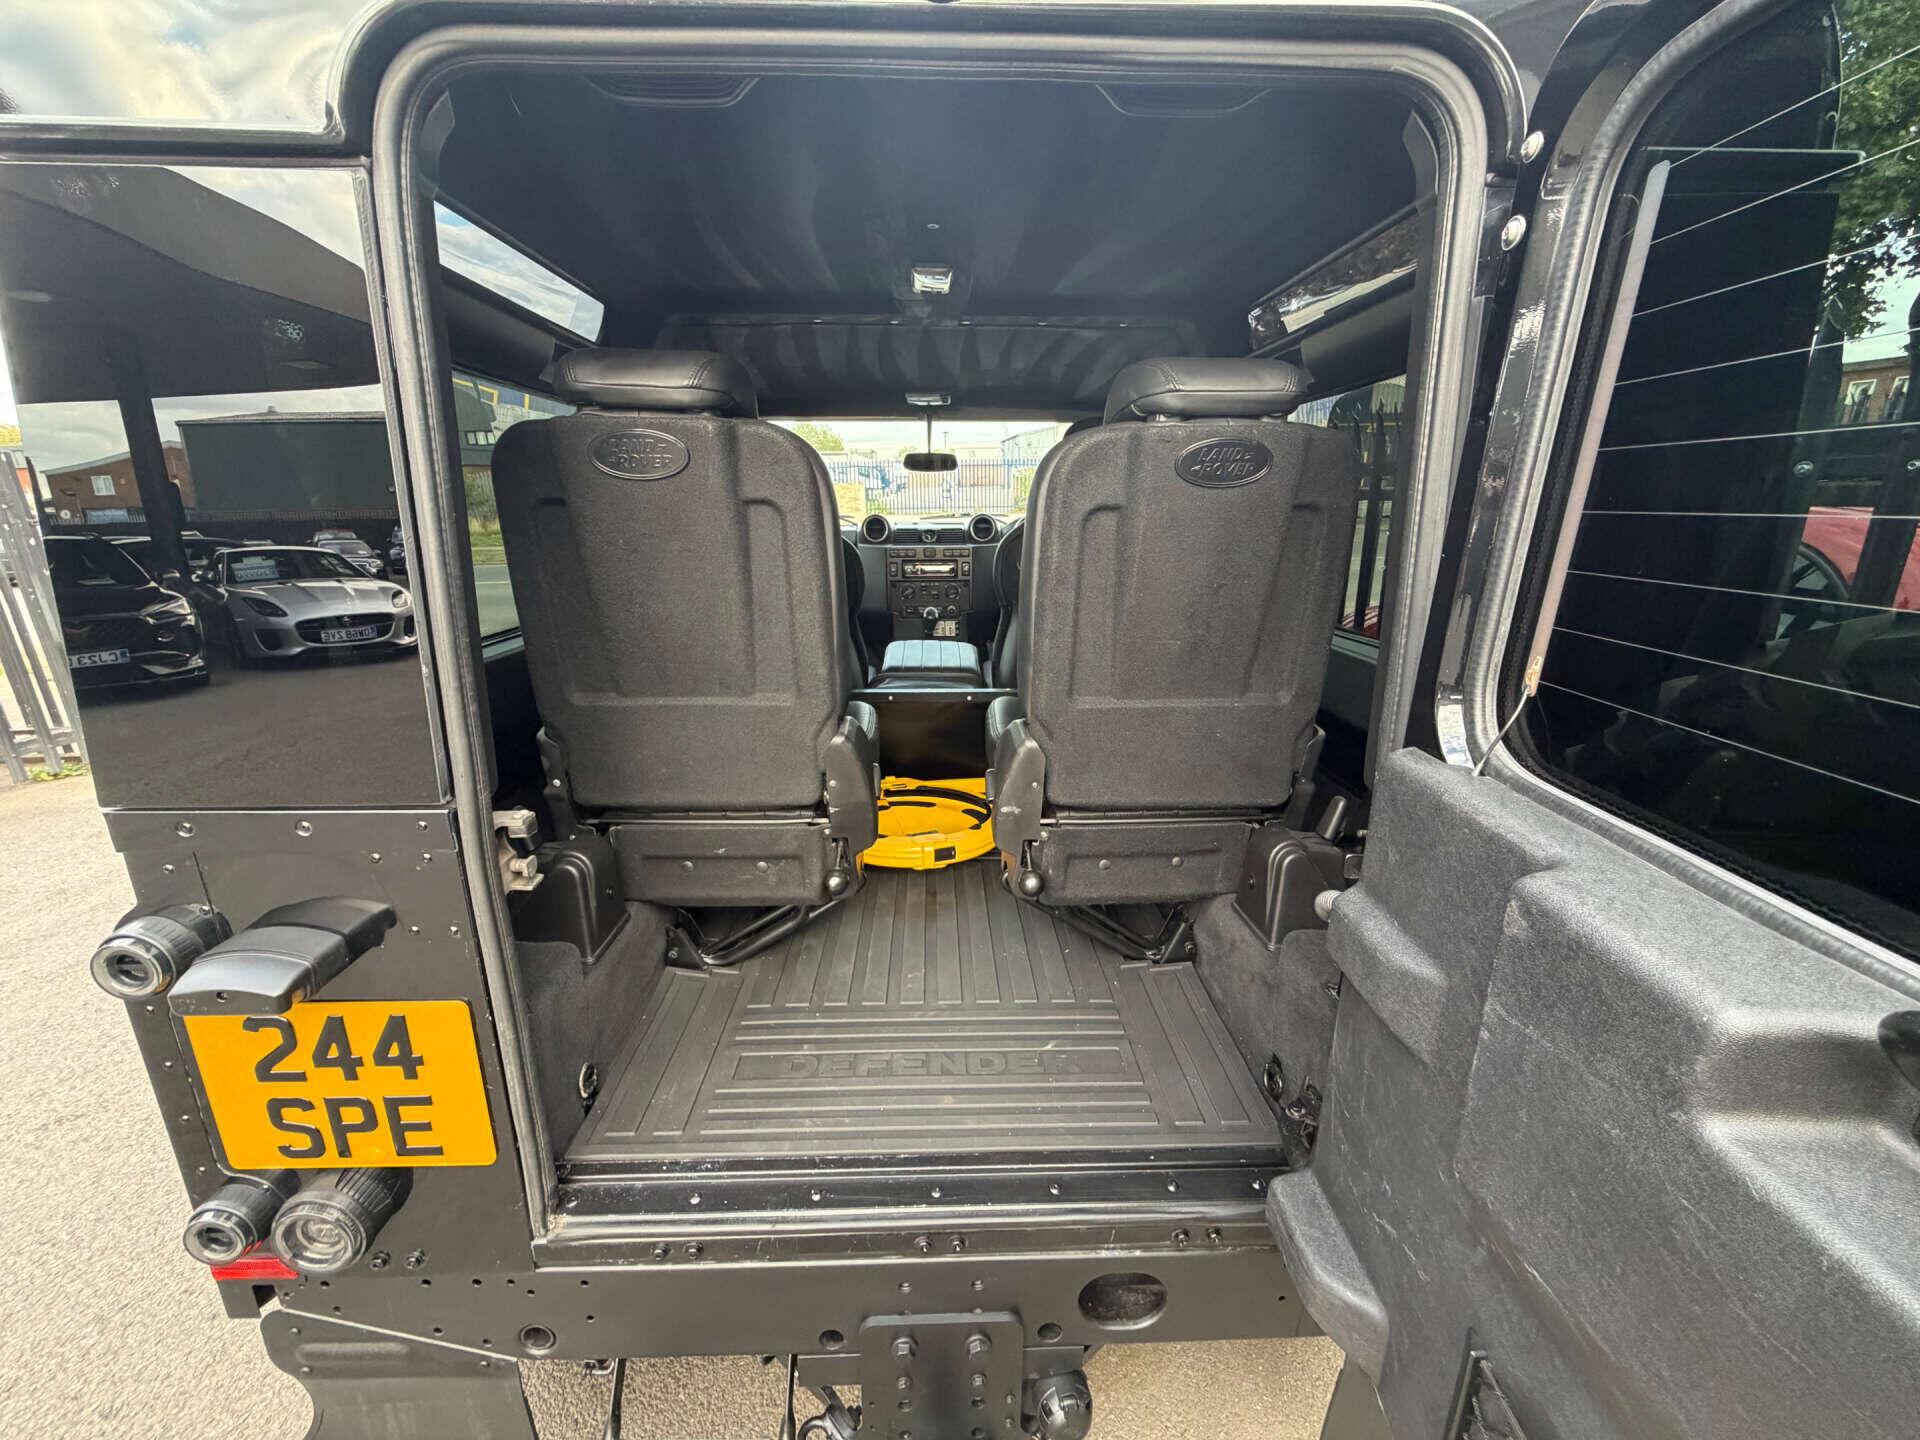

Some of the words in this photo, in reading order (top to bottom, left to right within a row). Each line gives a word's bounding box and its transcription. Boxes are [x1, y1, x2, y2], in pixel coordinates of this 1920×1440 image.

[1198, 447, 1244, 462] LAND
[1198, 462, 1256, 477] ROVER
[242, 1014, 424, 1083] 244
[783, 1051, 1082, 1077] DEFENDER
[266, 1095, 444, 1158] SPE
